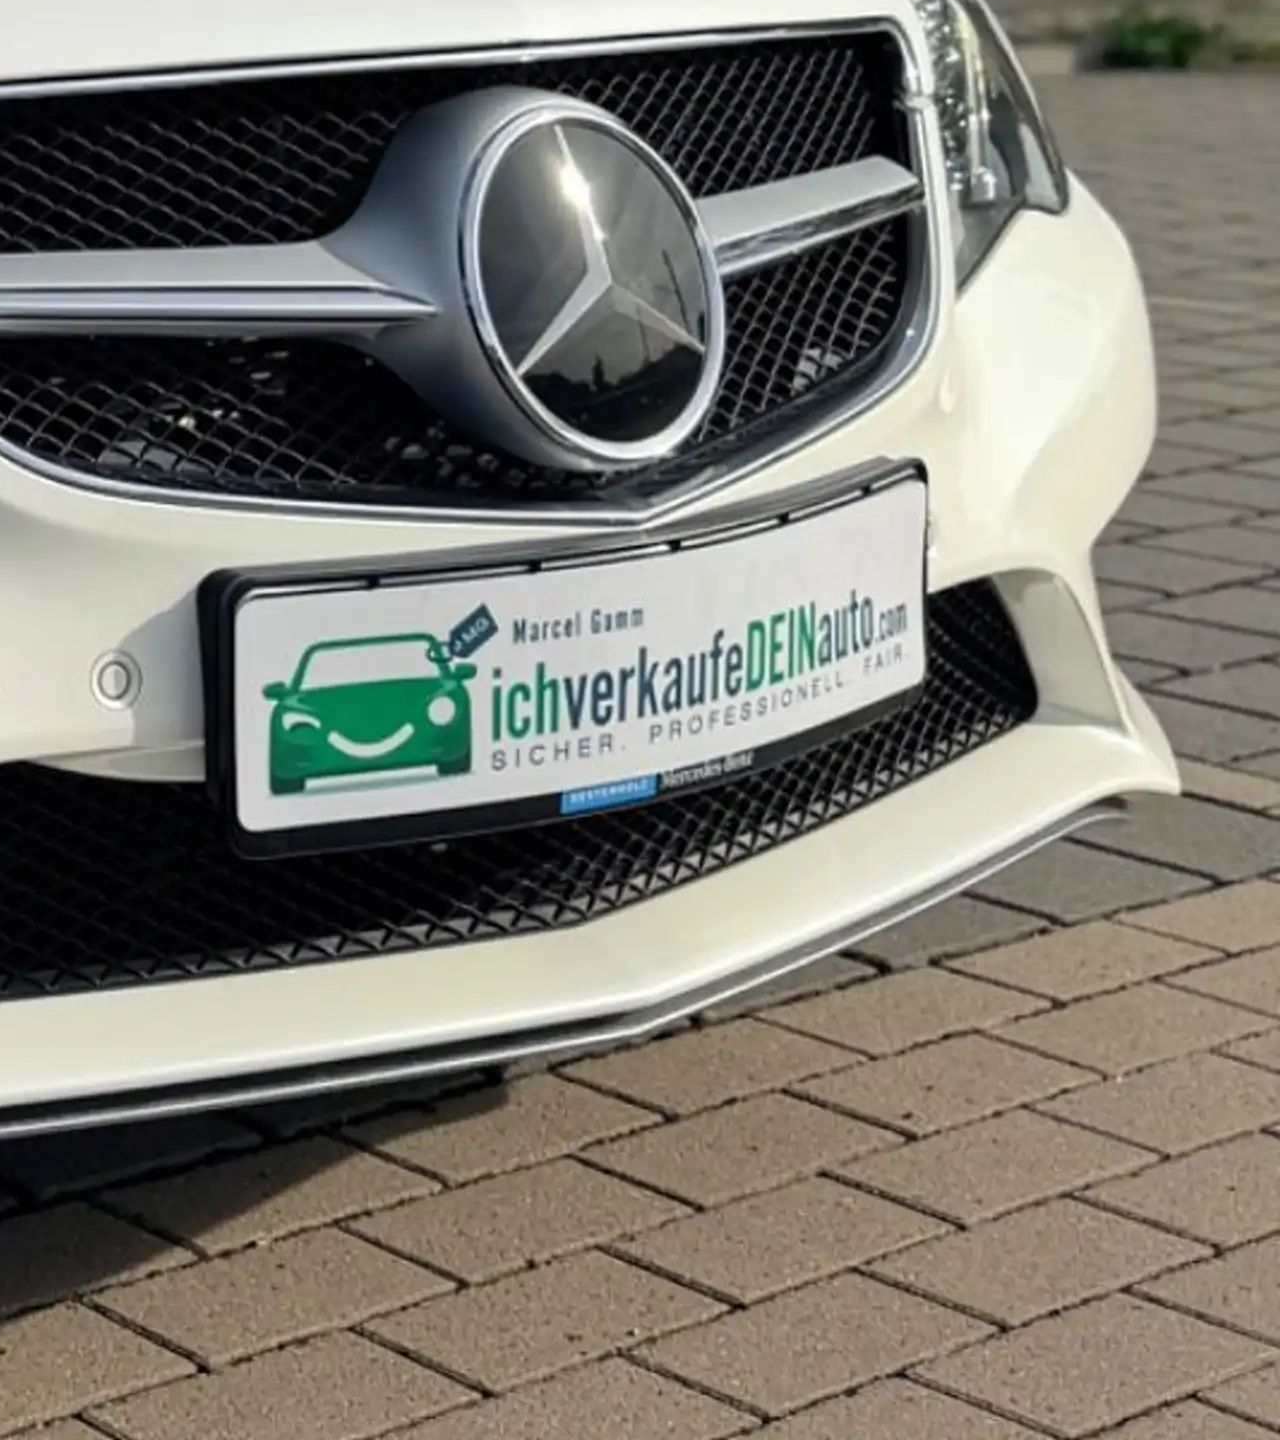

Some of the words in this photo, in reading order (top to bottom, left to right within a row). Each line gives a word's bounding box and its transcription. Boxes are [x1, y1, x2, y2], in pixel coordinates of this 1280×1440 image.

[513, 611, 581, 644] Marcel
[492, 588, 907, 742] ichverkaufeDEINauto.com
[491, 734, 625, 770] SICHER.
